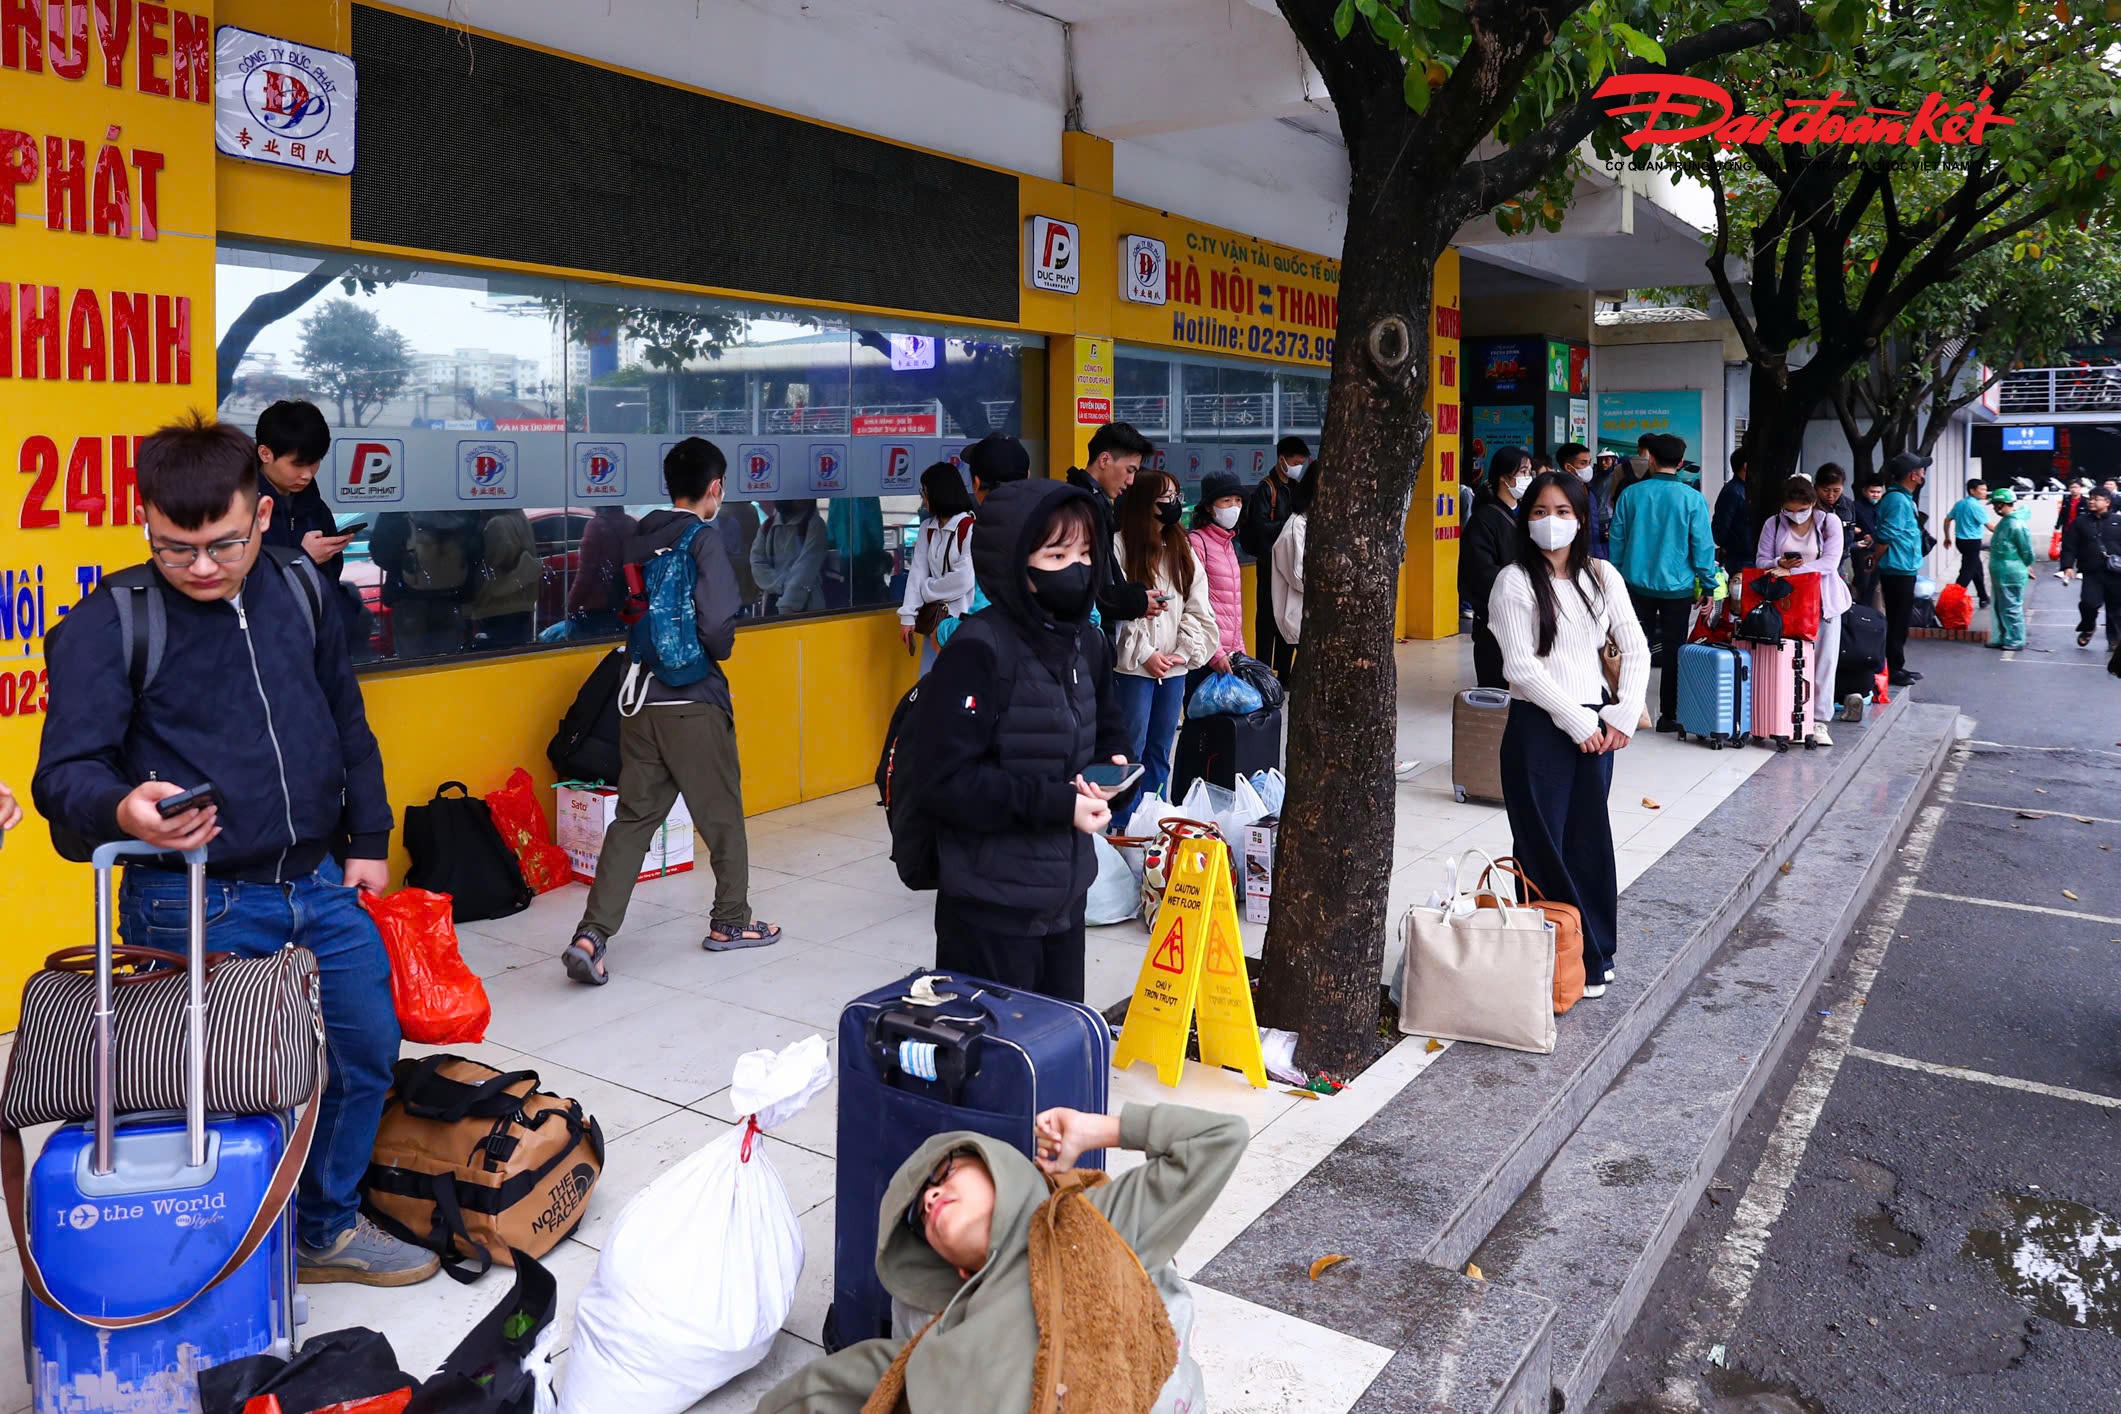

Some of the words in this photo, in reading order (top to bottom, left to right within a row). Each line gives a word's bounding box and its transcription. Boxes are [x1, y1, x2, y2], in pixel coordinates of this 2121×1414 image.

[238, 50, 267, 73] CÔNG
[270, 48, 284, 60] TY
[313, 66, 337, 93] PHÁT
[235, 127, 336, 164] 专业团队
[1186, 233, 1216, 254] C.TY
[1220, 241, 1248, 265] VẬN
[1251, 246, 1270, 268] TẢI
[1273, 254, 1308, 277] QUỐC
[1310, 260, 1323, 281] TẾ
[1037, 270, 1054, 281] DUC
[1056, 274, 1075, 285] PHAT
[1166, 255, 1202, 306] HÀ
[1211, 266, 1254, 322] NỘI
[1173, 310, 1244, 351] Hotline:
[341, 487, 366, 495] DUC
[571, 799, 587, 812] Sato
[1167, 896, 1181, 905] WET
[1180, 897, 1201, 911] FLOOR
[1174, 882, 1200, 896] CAUTION
[548, 1172, 573, 1202] THE
[57, 1210, 66, 1227] I
[103, 1204, 144, 1222] the
[151, 1192, 227, 1216] World
[531, 1183, 576, 1235] NORTH
[548, 1195, 577, 1232] FACE
